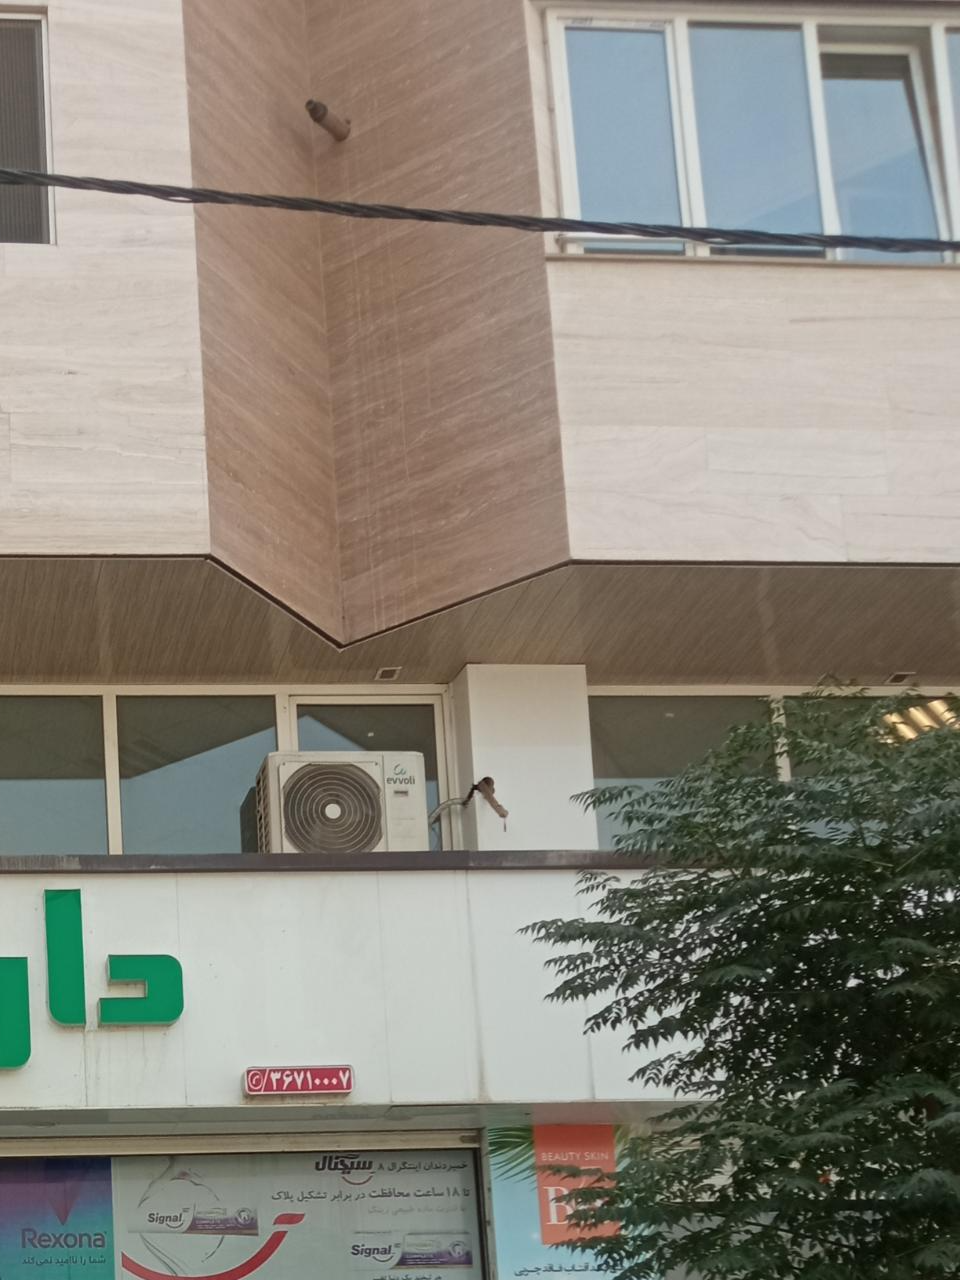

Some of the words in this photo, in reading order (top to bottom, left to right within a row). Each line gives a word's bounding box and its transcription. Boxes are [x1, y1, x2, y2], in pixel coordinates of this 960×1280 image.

[386, 776, 416, 785] evvoli
[541, 1152, 581, 1161] BEAUTY
[583, 1151, 610, 1161] SKIN
[368, 1187, 411, 1198] محافظت
[414, 1186, 444, 1198] ساعت
[147, 1212, 183, 1225] Signal
[21, 1227, 106, 1249] Rexona
[351, 1244, 392, 1257] Signal
[88, 1254, 106, 1265] شما
